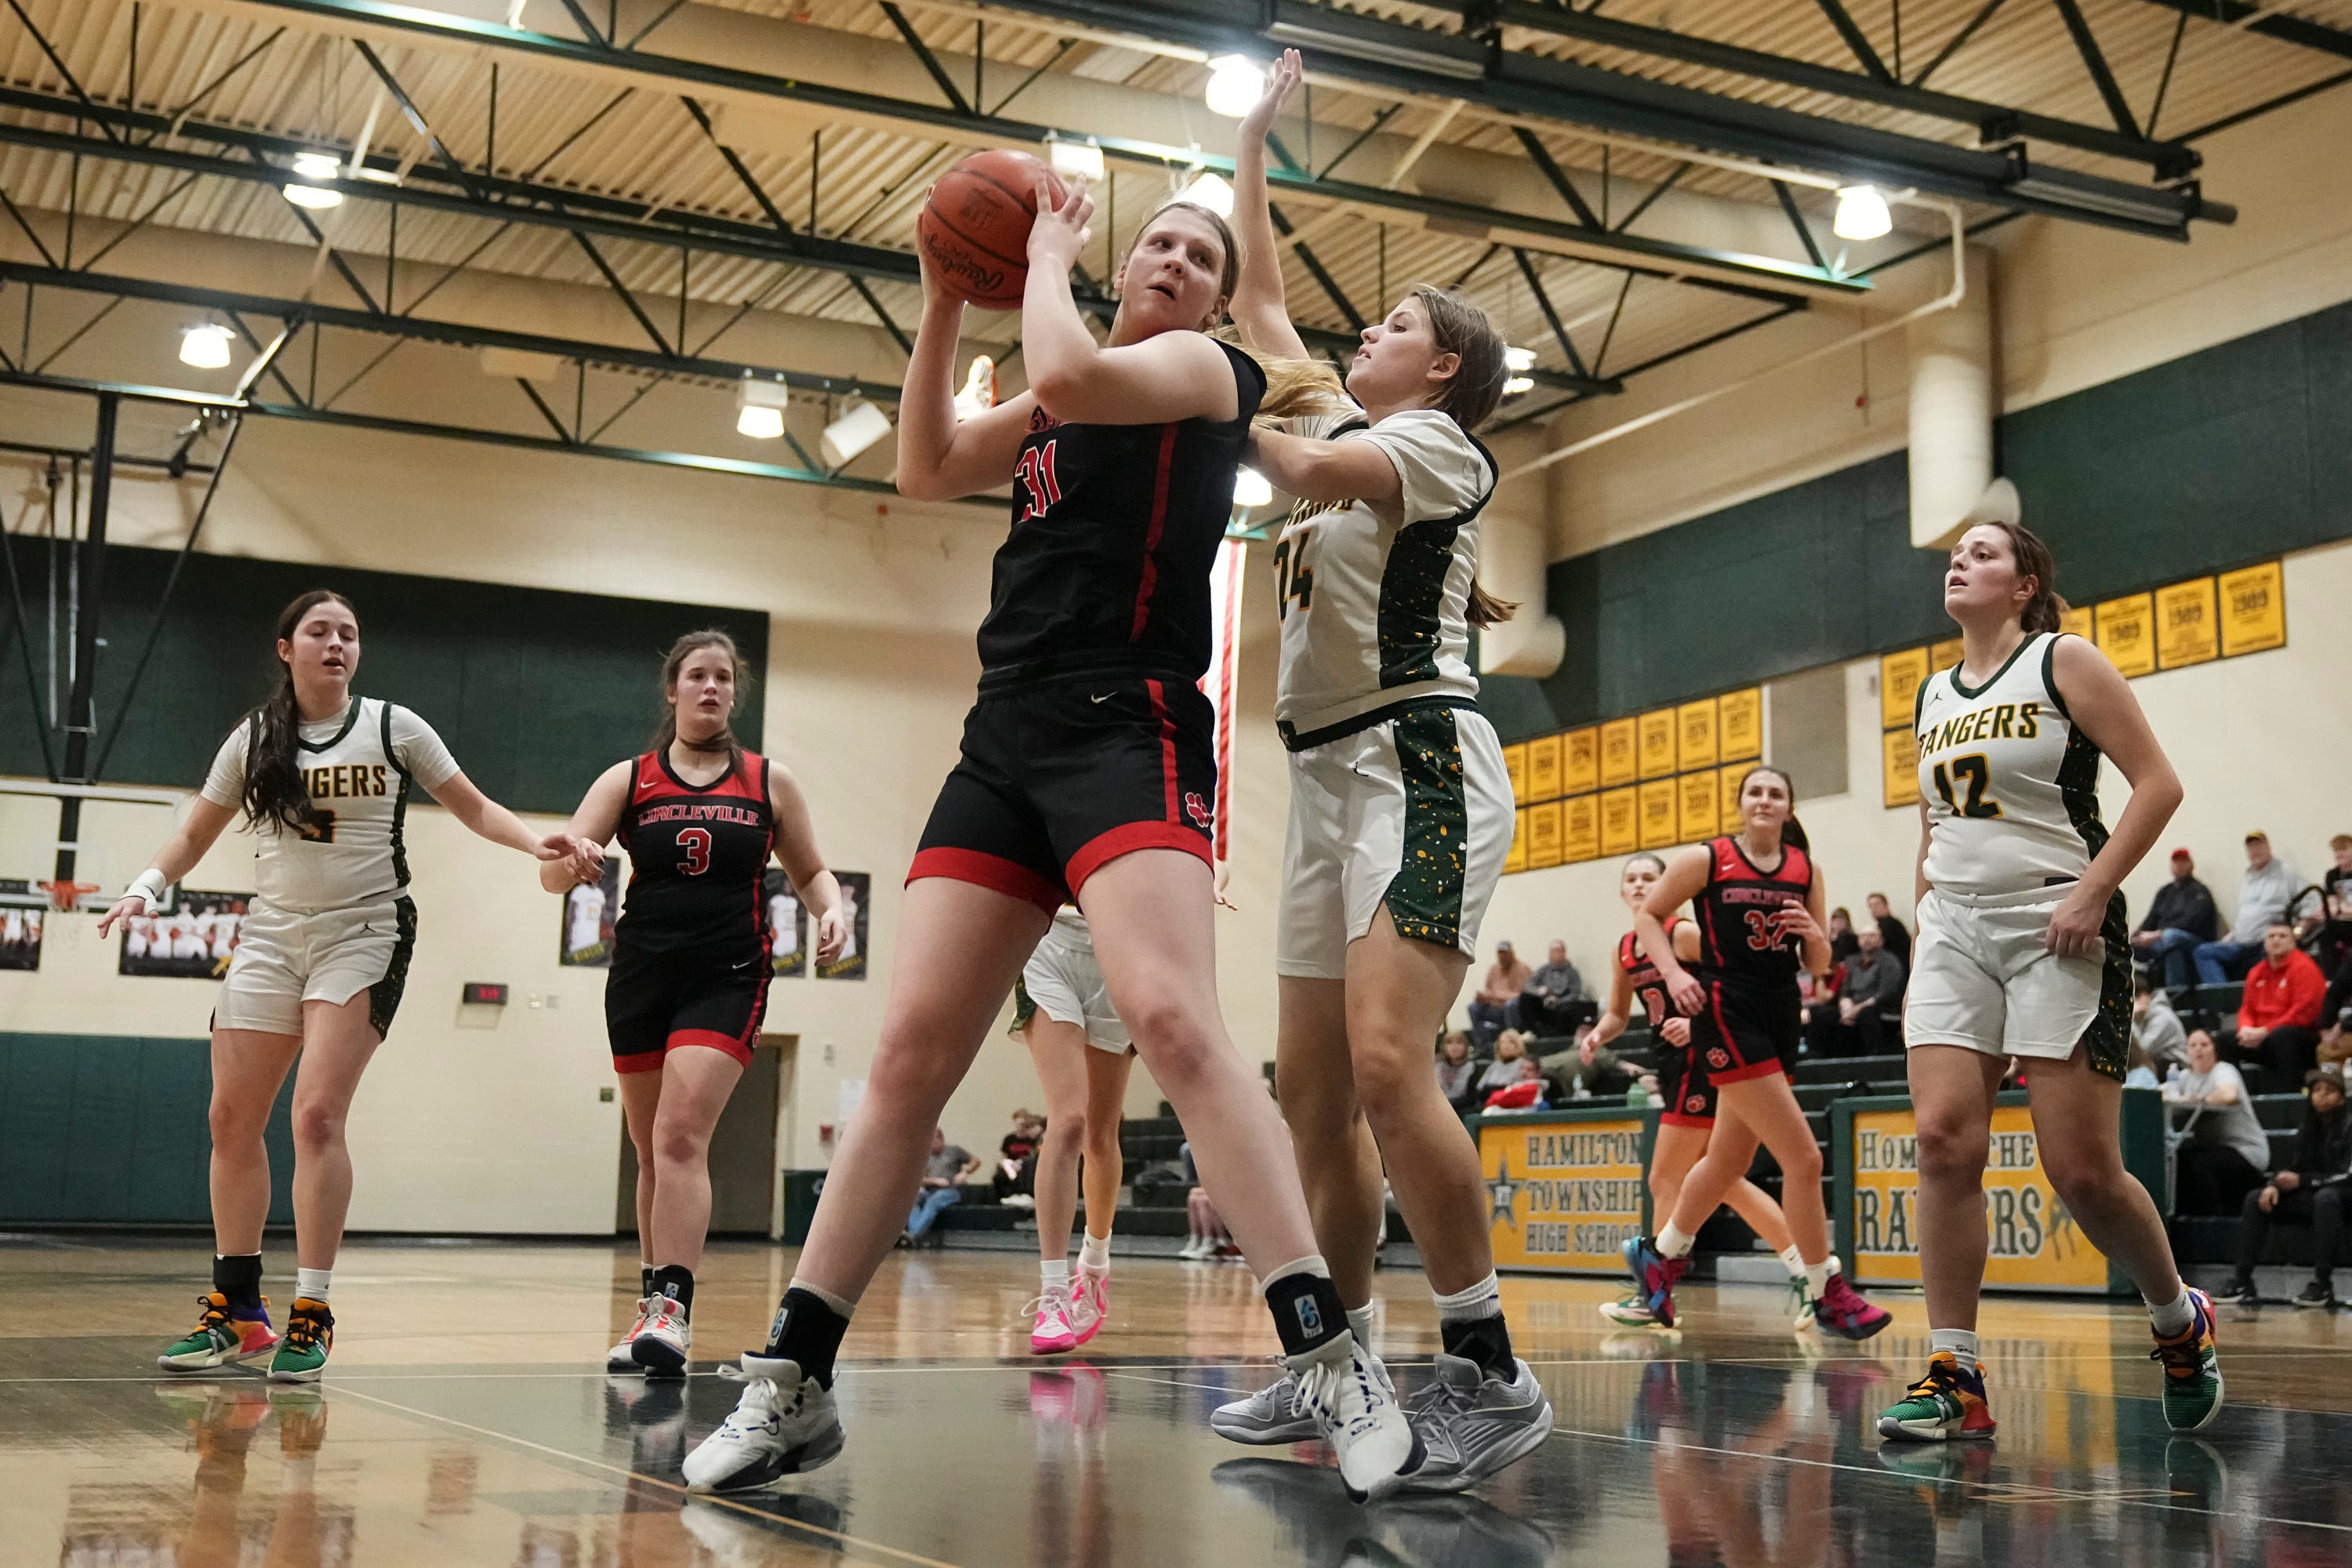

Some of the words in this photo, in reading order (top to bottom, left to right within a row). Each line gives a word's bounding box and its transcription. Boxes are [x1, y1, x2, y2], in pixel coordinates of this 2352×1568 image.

[1014, 439, 1061, 522] 31
[302, 764, 387, 798] GERS
[1933, 752, 2004, 818] 12
[677, 827, 712, 876] 3
[1744, 909, 1788, 953] 32
[1528, 1131, 1642, 1167] HAMILTON
[1528, 1223, 1568, 1253] HIGH
[1574, 1223, 1642, 1253] SCHOO
[1853, 1186, 2042, 1255] RARS
